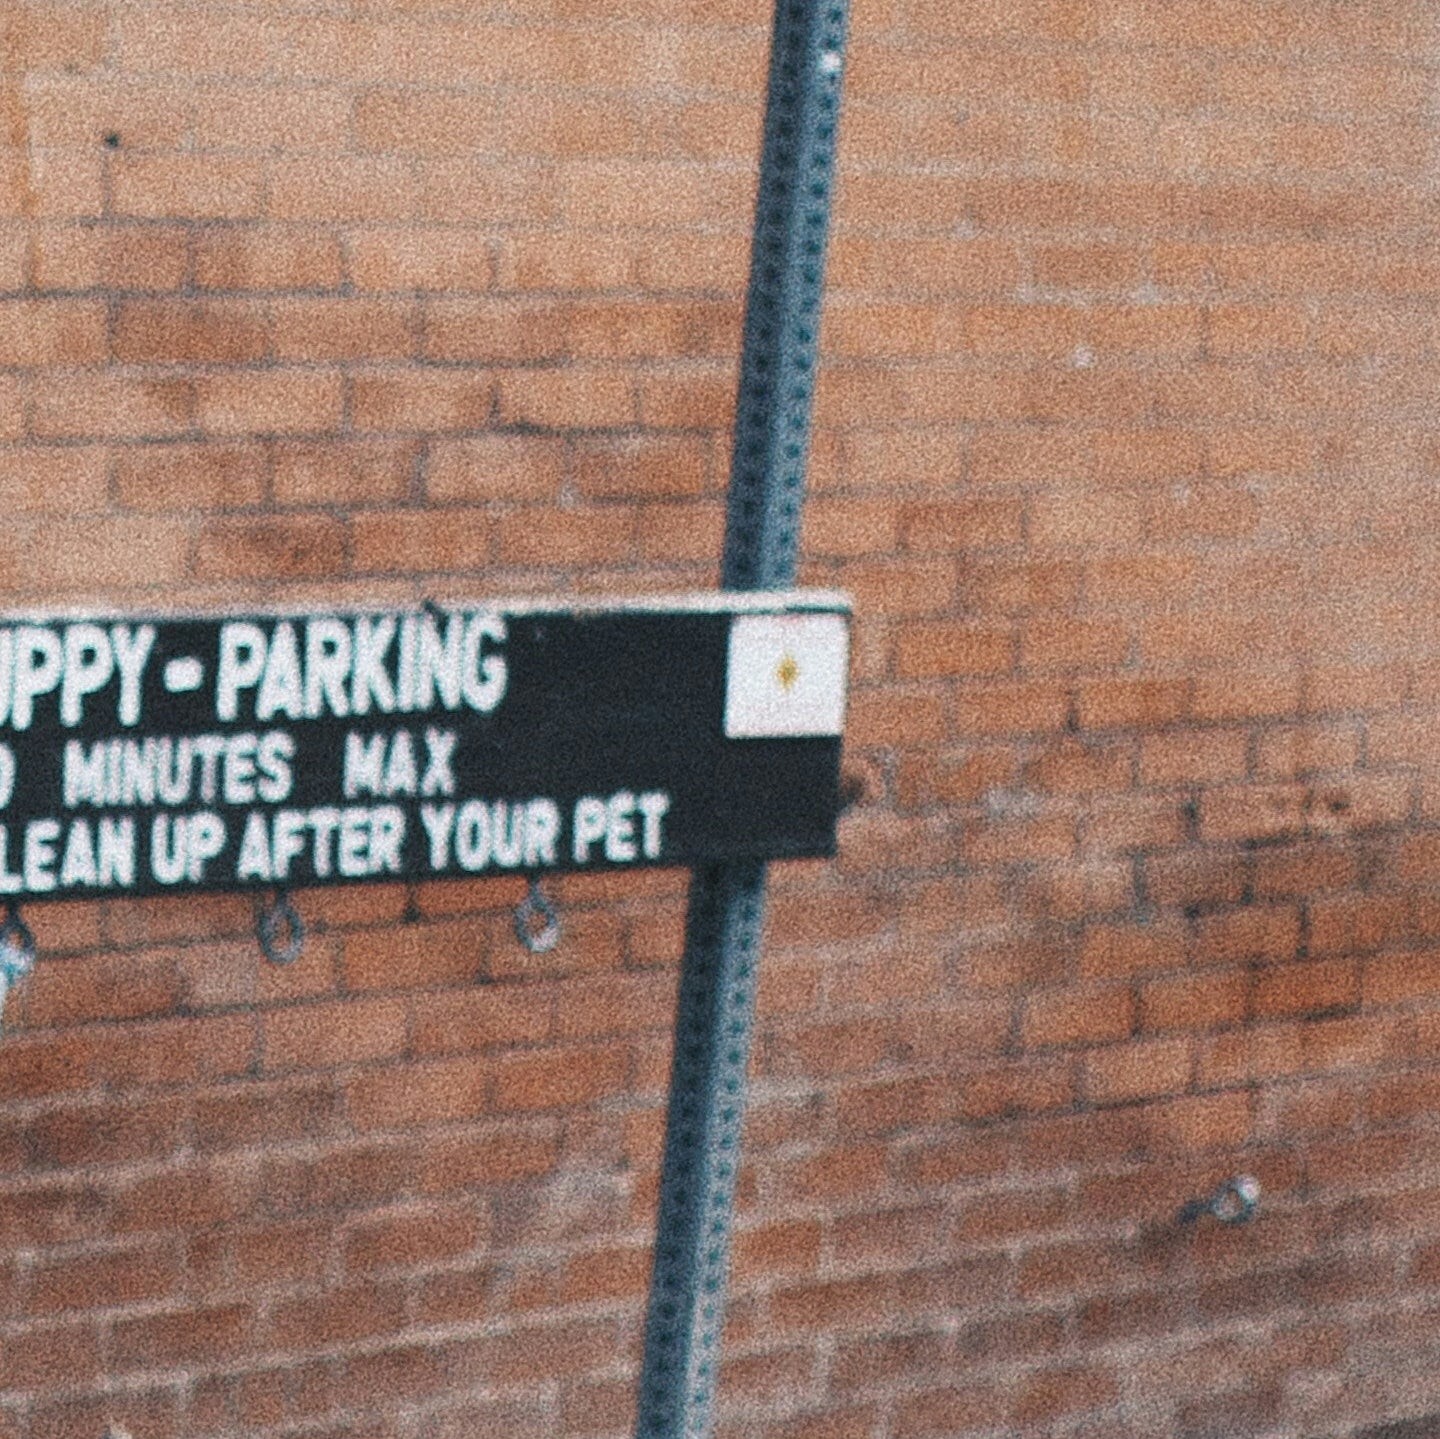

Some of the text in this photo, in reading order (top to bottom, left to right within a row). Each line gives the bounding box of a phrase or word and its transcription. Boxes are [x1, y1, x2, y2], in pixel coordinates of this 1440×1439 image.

[64, 730, 294, 805] MINUTES
[345, 726, 455, 796] MAX
[152, 812, 225, 883] UP
[238, 805, 405, 878] AFTER
[422, 799, 559, 870] YOUR
[574, 790, 668, 860] PET
